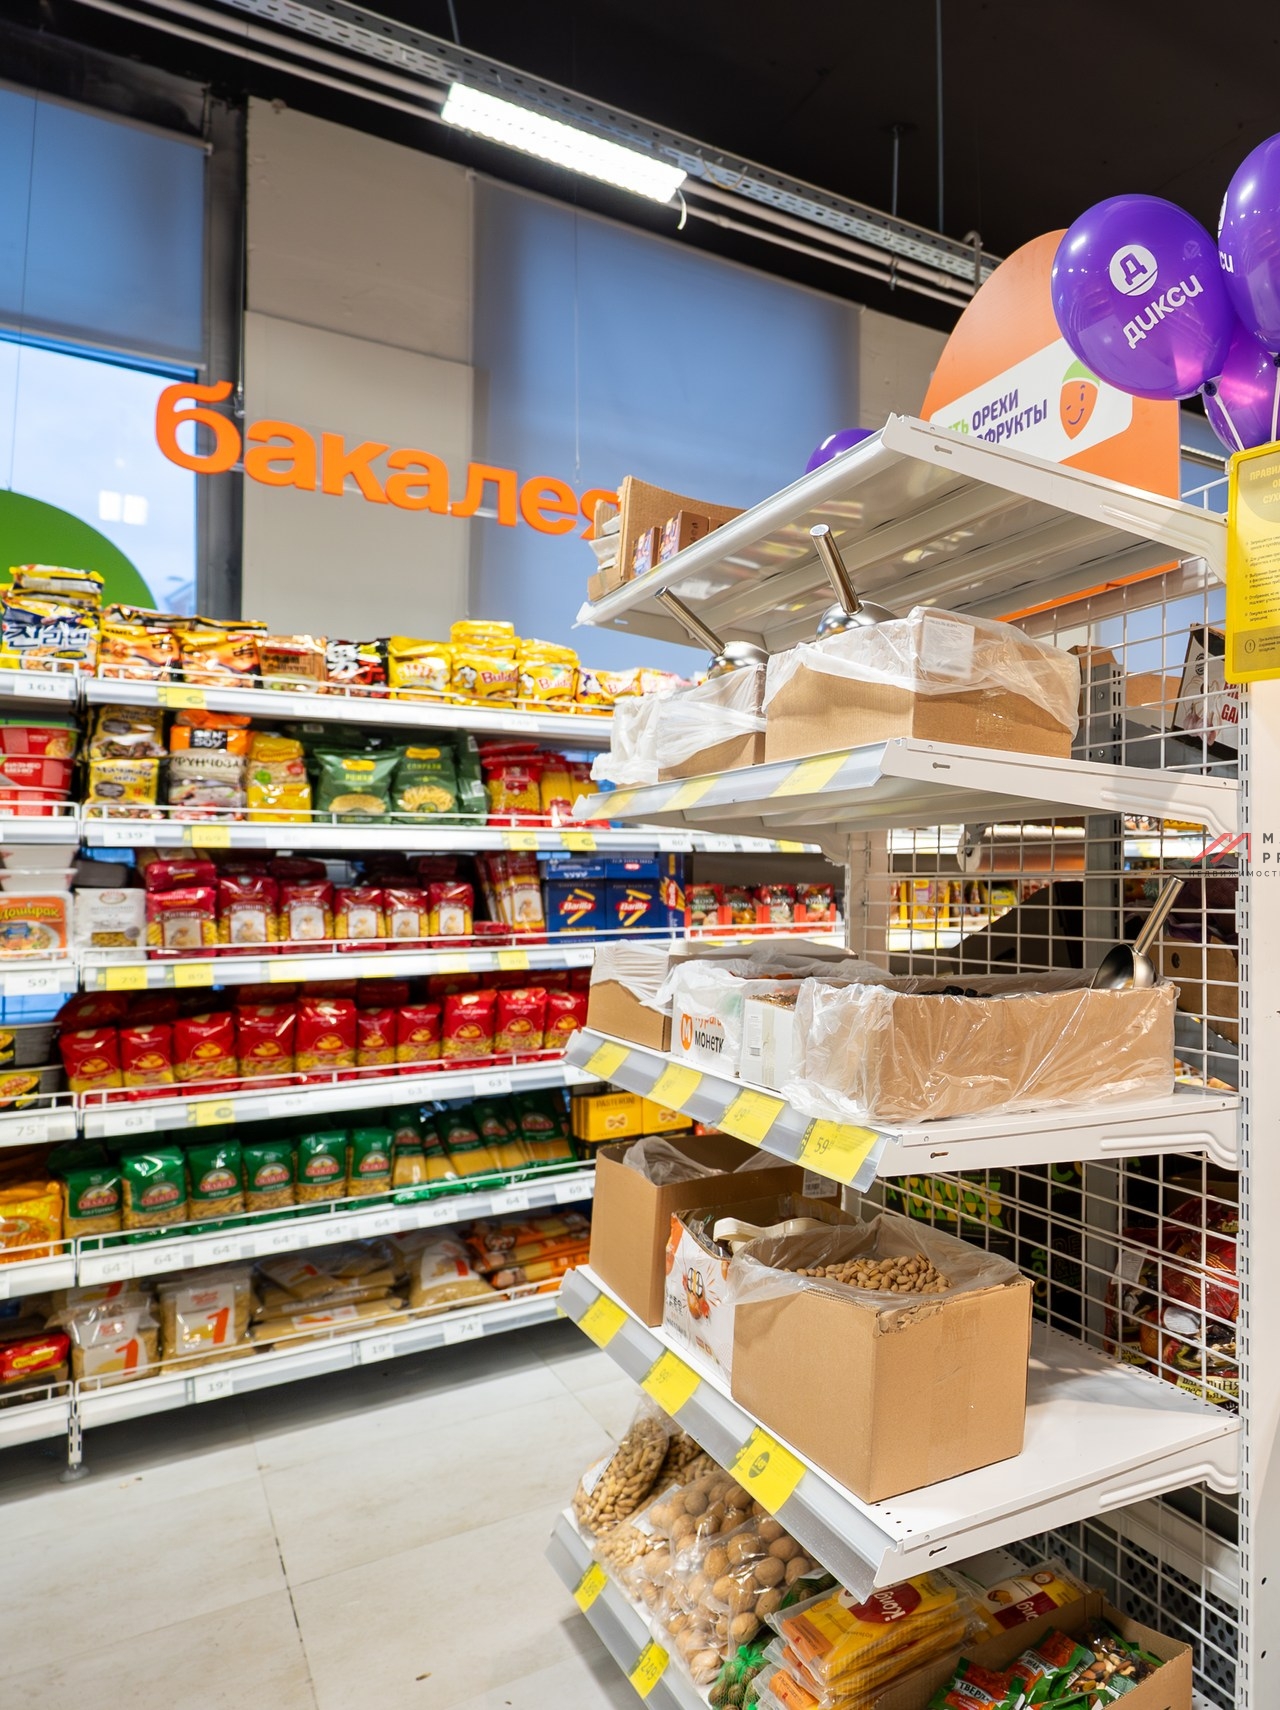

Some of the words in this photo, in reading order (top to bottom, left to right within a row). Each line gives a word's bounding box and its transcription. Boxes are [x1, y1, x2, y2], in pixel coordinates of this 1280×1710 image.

[1122, 274, 1204, 349] дикси
[972, 388, 1019, 431] ОРЕХИ
[976, 399, 1047, 443] ФРУКТЫ
[155, 380, 621, 541] бакалея
[562, 900, 593, 912] Barilla
[619, 900, 649, 912] Barilla
[28, 978, 48, 988] 59
[694, 1030, 724, 1054] монетк
[814, 1137, 830, 1154] 59
[102, 1263, 121, 1274] 64
[154, 1254, 172, 1264] 64
[208, 1381, 224, 1392] 19
[1015, 1600, 1040, 1623] ong
[638, 1659, 658, 1681] 249
[960, 1681, 991, 1703] ТВЕРД
